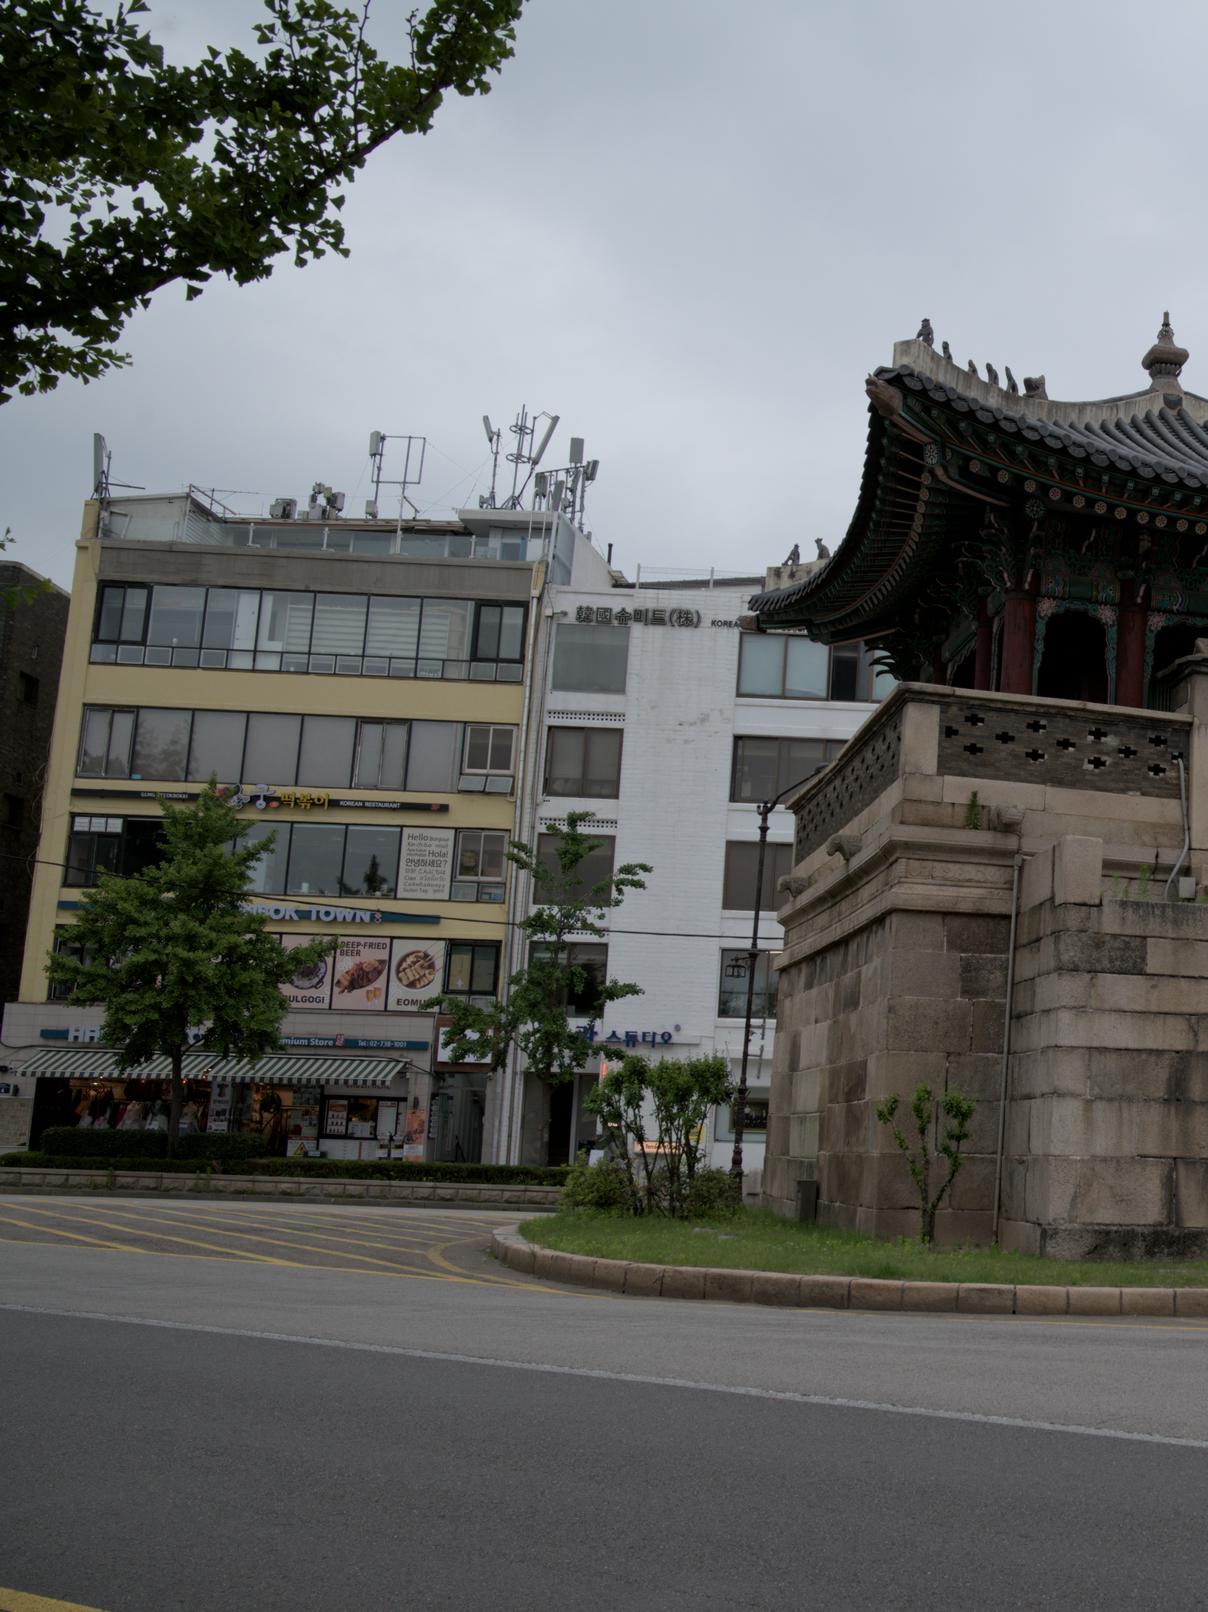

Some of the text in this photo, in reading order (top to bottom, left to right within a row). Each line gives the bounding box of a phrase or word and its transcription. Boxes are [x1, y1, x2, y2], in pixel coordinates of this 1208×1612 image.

[711, 619, 739, 628] KOREA
[407, 833, 429, 841] Hello
[428, 850, 449, 858] Hola!
[308, 908, 372, 923] TOWN
[287, 995, 325, 1004] ULGOGI
[310, 1038, 334, 1046] Store
